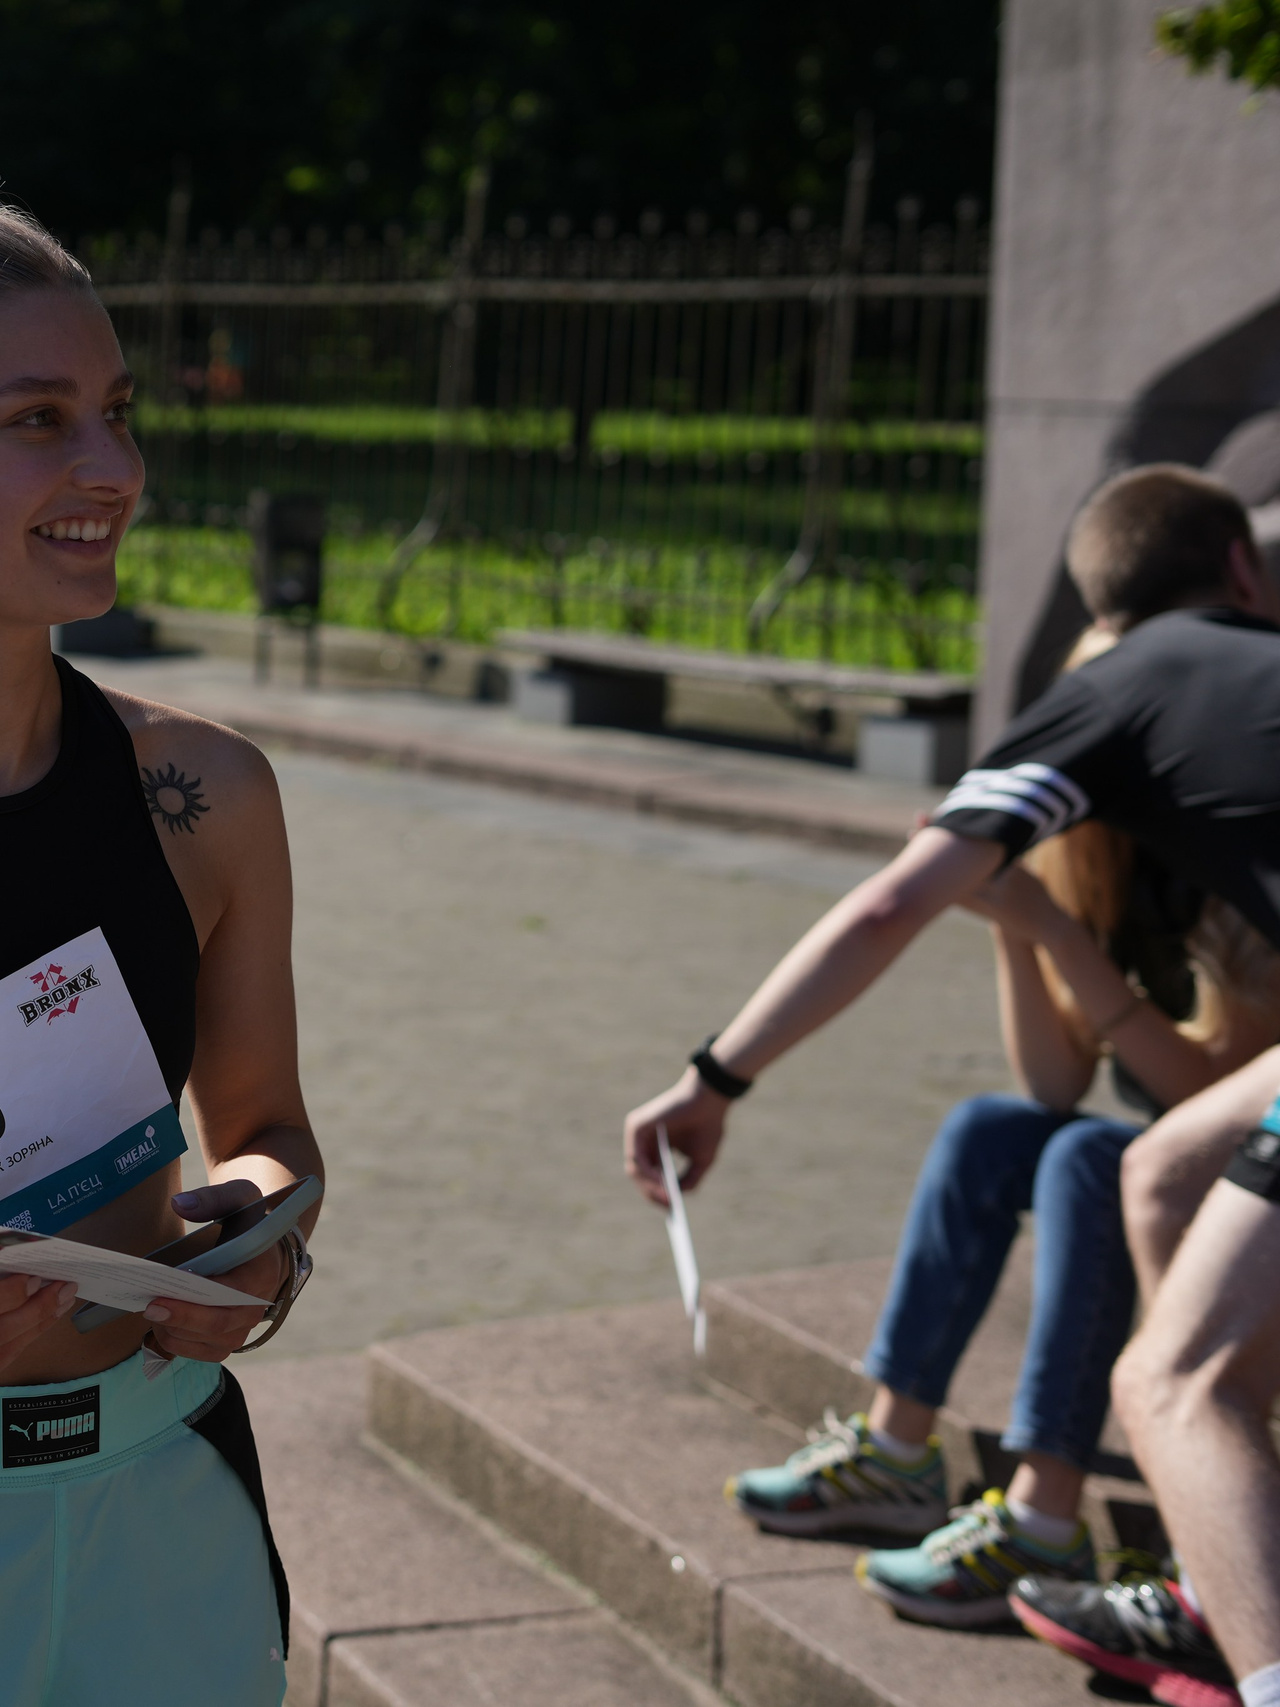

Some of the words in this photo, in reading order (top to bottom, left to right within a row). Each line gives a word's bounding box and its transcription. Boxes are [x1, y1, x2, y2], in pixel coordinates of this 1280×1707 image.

[18, 965, 100, 1026] BRONX
[6, 1135, 54, 1168] ЗОРЯНА
[48, 1193, 67, 1210] LA
[2, 1210, 30, 1228] UNDER
[9, 1400, 57, 1408] ESTABLISHED
[60, 1396, 79, 1404] SINCE
[36, 1411, 95, 1442] PUMA
[67, 1447, 89, 1456] SPORT
